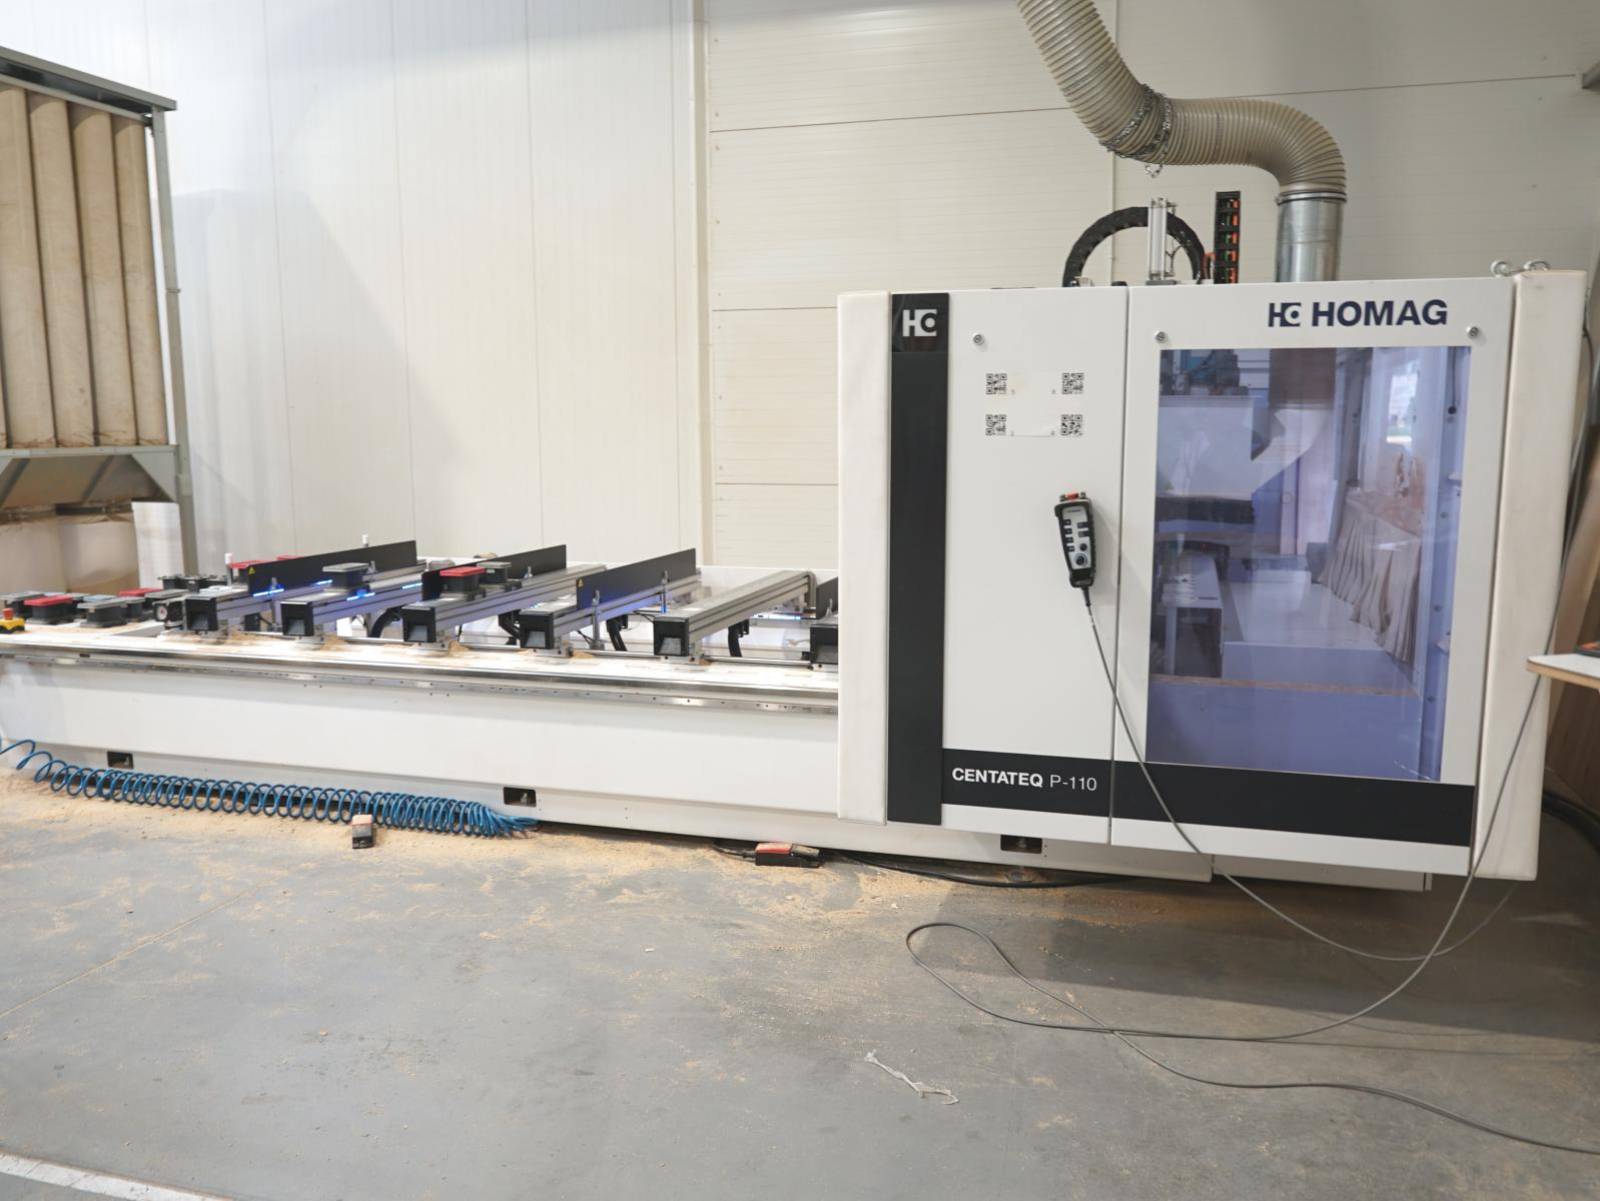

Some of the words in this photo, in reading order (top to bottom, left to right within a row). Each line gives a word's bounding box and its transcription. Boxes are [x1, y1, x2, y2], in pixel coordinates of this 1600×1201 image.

[1312, 299, 1448, 327] HOMAG
[952, 767, 1043, 788] CENTATEQ
[1050, 774, 1097, 791] P-110
